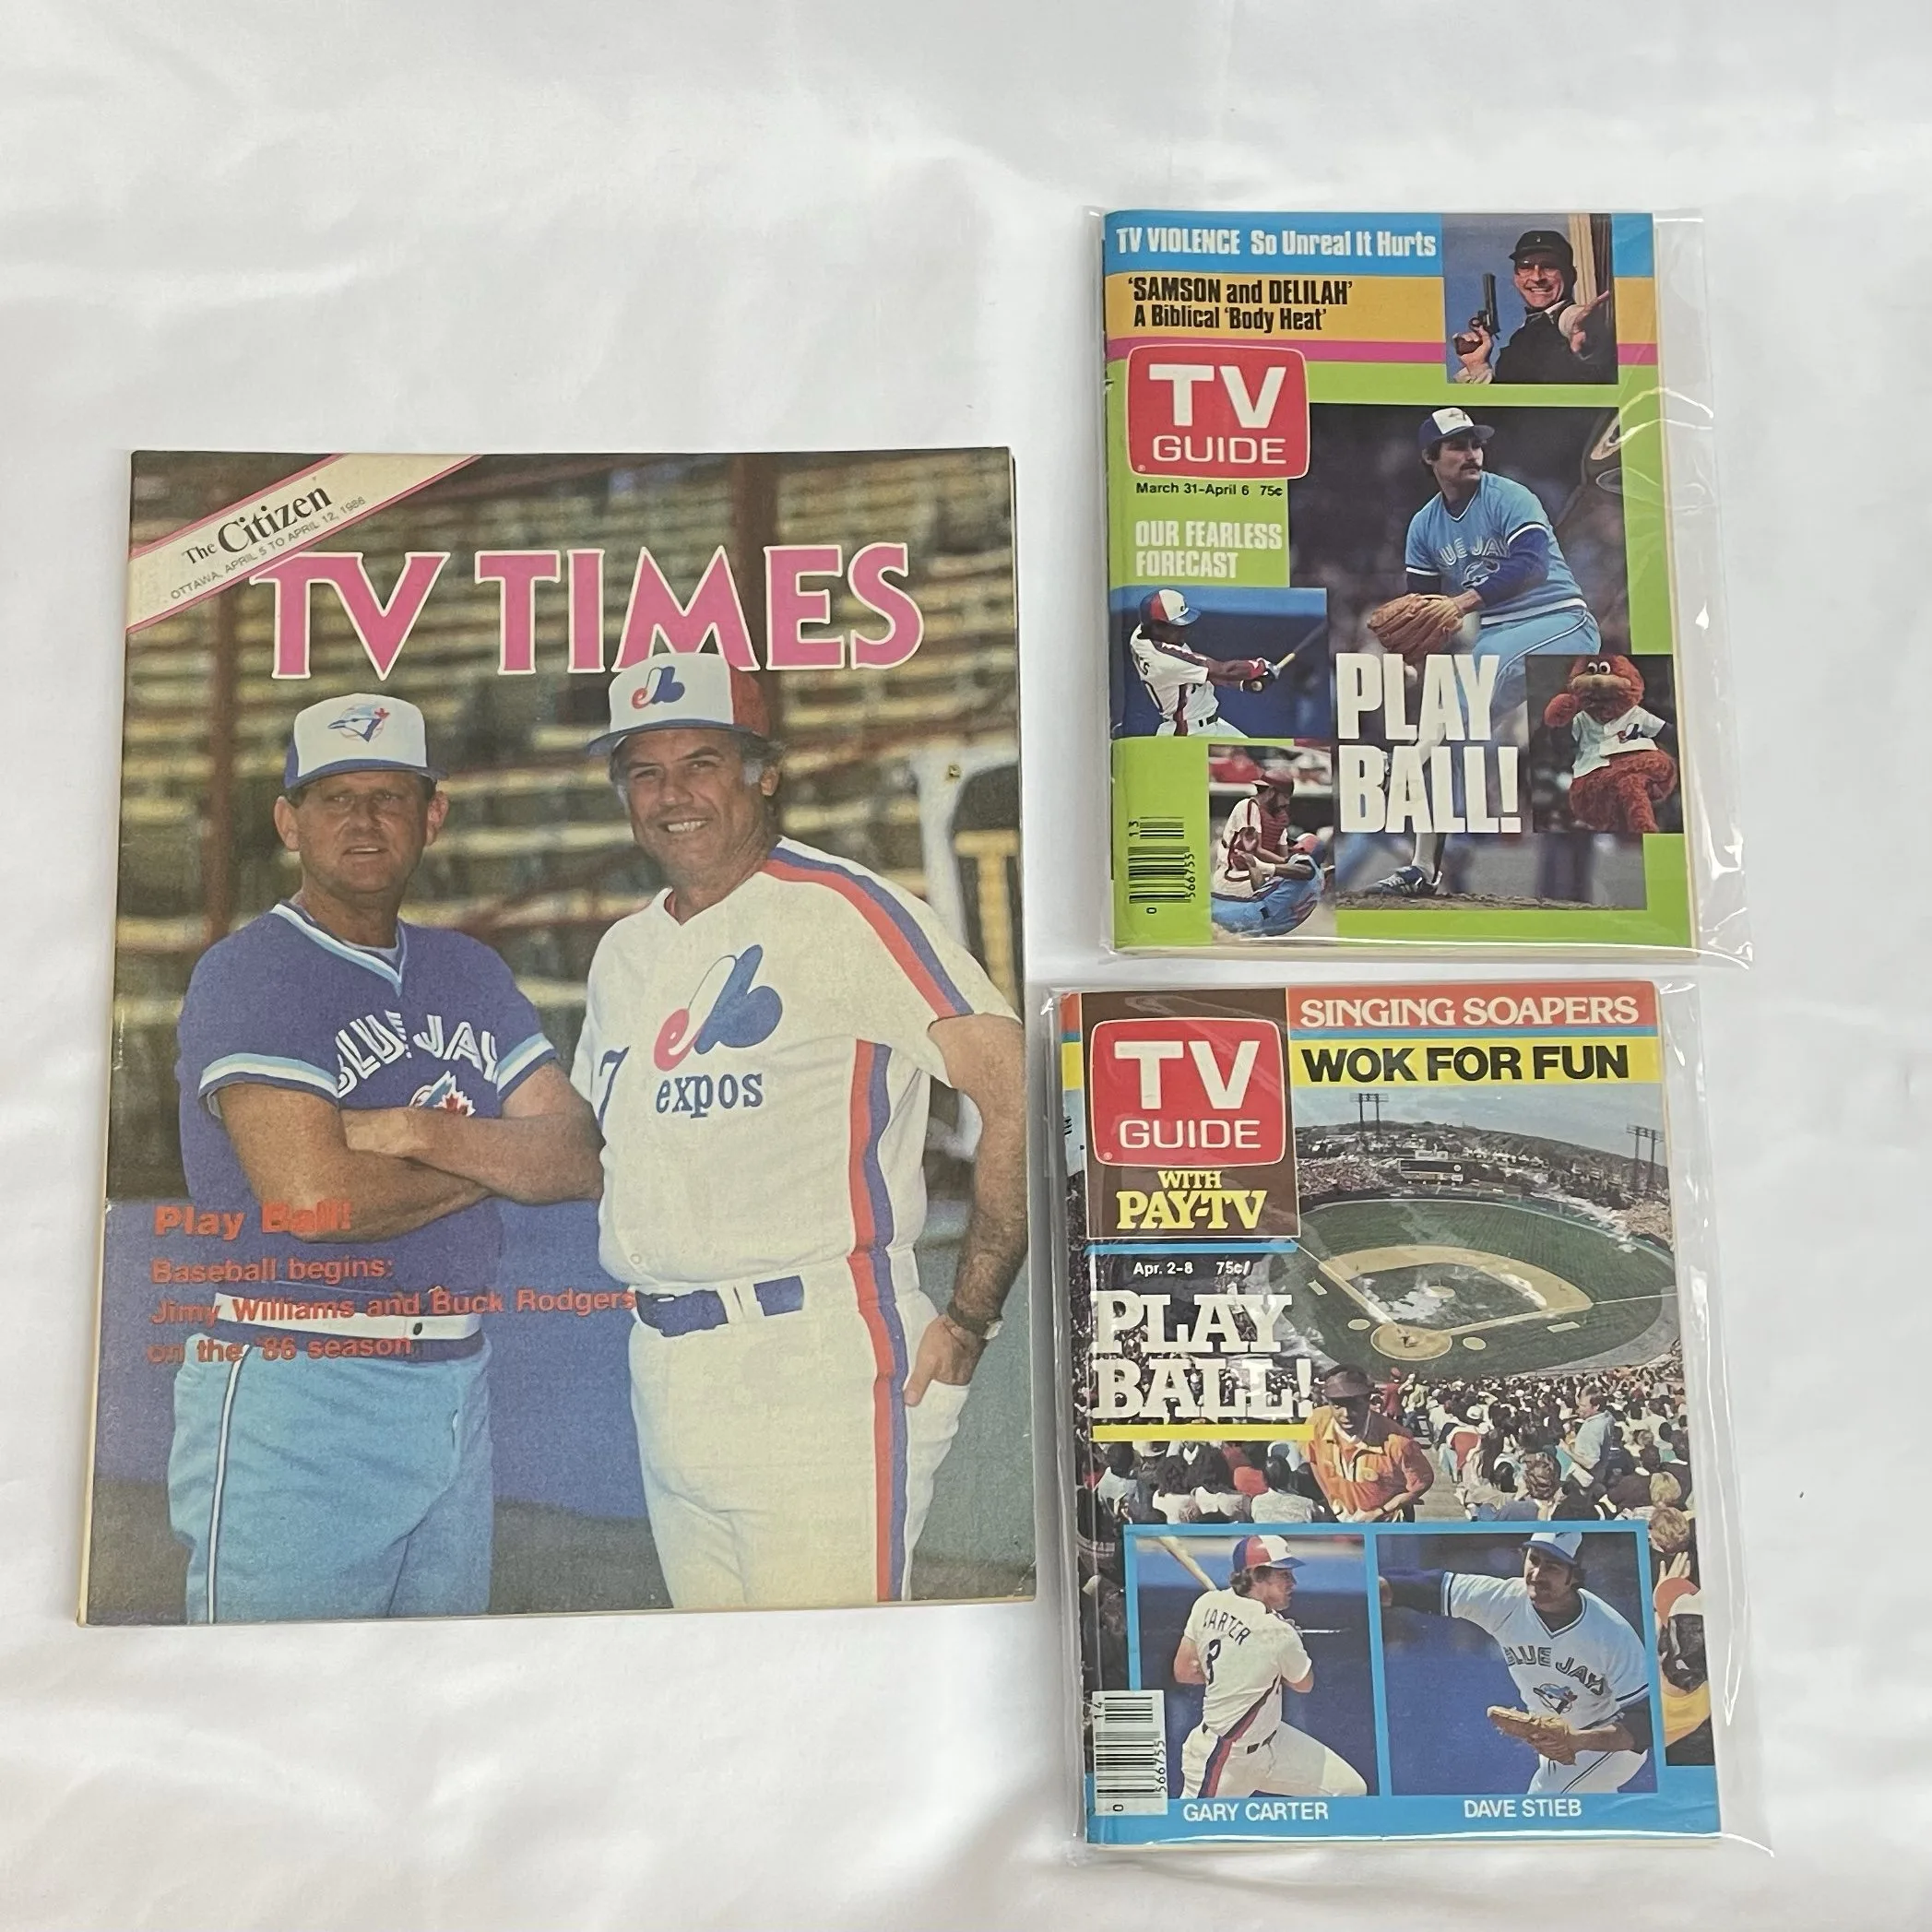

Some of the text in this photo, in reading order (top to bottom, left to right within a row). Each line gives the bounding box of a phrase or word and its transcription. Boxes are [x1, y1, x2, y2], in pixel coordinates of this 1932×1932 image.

[1116, 227, 1436, 256] TV VIOLENCE So Unreal It Hurts
[1227, 280, 1262, 304] and
[1133, 304, 1146, 326] A
[1151, 303, 1220, 328] Biblical
[1149, 363, 1287, 429] TV
[1153, 435, 1286, 464] GUIDE
[1136, 482, 1179, 494] March
[1183, 483, 1237, 497] 31-April
[1241, 485, 1250, 496] 6
[184, 487, 332, 564] The Citizen
[225, 553, 258, 573] APRIL
[260, 547, 267, 556] 5
[269, 538, 285, 551] TO
[289, 522, 320, 541] APRIL
[340, 496, 367, 515] 1986
[1135, 520, 1283, 550] OUR FEARLESS
[1135, 550, 1239, 578] FORECAST
[249, 541, 925, 681] TV TIMES
[1335, 653, 1501, 741] PLAY
[1338, 744, 1522, 835] BALL!
[1300, 996, 1640, 1027] SINGING SOAPERS
[1114, 1040, 1261, 1109] TV
[1301, 1045, 1629, 1083] WOK FOR FUN
[656, 1073, 764, 1119] expos
[1120, 1120, 1262, 1149] GUIDE
[1157, 1170, 1222, 1189] WITH
[154, 1199, 352, 1240] Play Ball!
[1116, 1190, 1267, 1230] PAY-TV
[150, 1255, 393, 1285] Baseball begins:
[1133, 1262, 1163, 1277] Apr.
[1167, 1262, 1193, 1274] 2-8
[232, 1297, 355, 1322] Williams
[366, 1292, 421, 1317] and
[430, 1286, 504, 1314] Buck
[516, 1286, 636, 1317] Rodgers
[1090, 1290, 1292, 1353] PLAY
[148, 1343, 184, 1364] on
[196, 1339, 243, 1363] the
[307, 1335, 412, 1359] season
[1092, 1358, 1313, 1418] BALL!
[1183, 1801, 1329, 1822] GARY CARTER
[1464, 1798, 1582, 1819] DAVE STIEB
